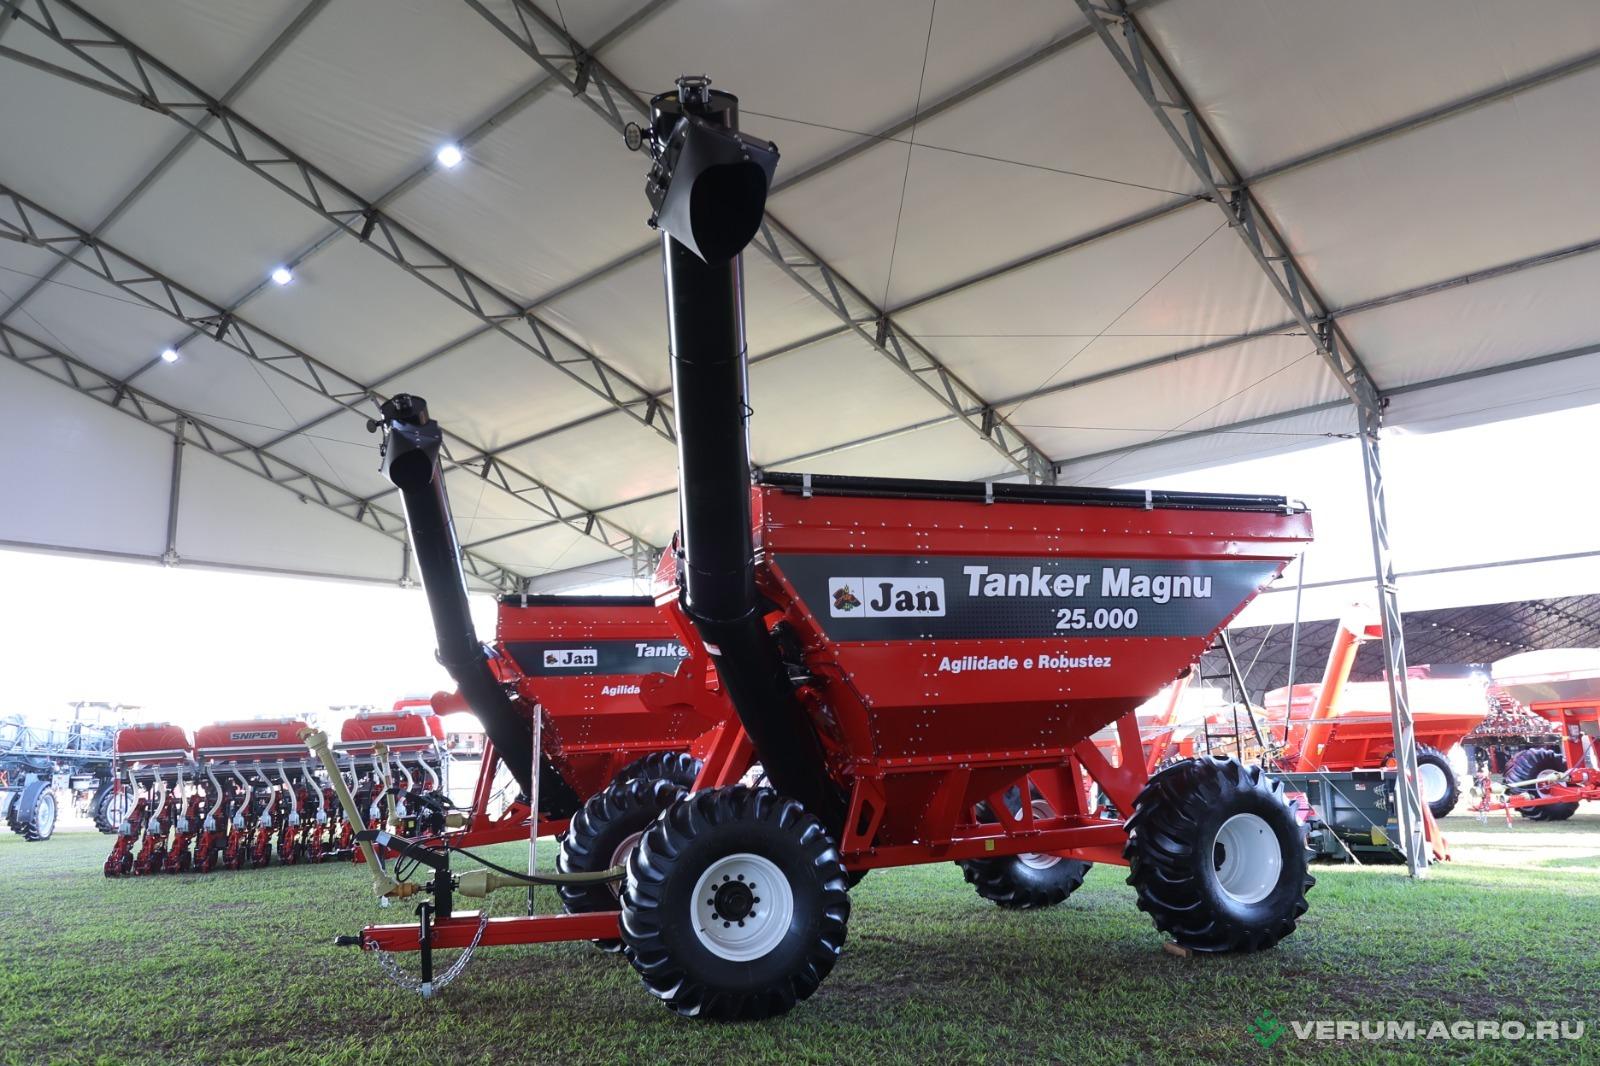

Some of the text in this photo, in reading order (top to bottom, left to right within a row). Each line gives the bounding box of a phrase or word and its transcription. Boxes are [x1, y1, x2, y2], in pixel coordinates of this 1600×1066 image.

[963, 565, 1212, 603] Tanker Magnu
[870, 582, 940, 613] Jan
[1055, 608, 1138, 630] 25.000
[562, 652, 594, 665] Jan
[635, 643, 691, 657] Tanke
[938, 655, 1112, 674] Agilidade e Robustez
[231, 731, 278, 740] SNIPER
